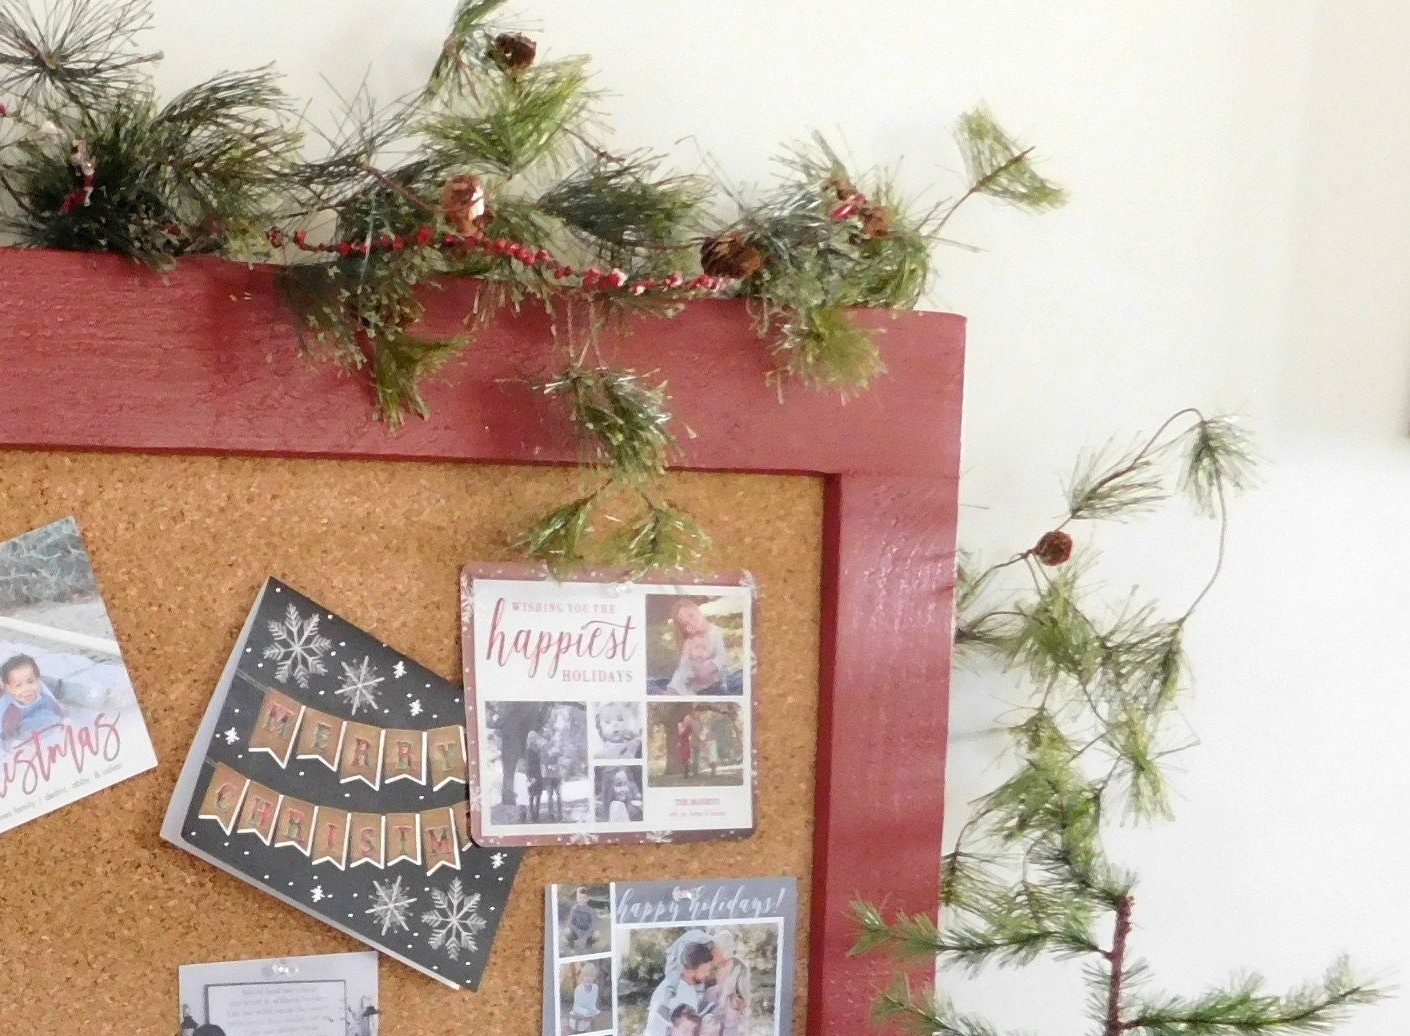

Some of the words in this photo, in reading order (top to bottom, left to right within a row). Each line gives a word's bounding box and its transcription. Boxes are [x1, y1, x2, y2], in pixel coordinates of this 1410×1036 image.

[511, 601, 564, 613] WISHING
[567, 603, 590, 614] YOU
[593, 604, 616, 615] THE
[486, 597, 637, 679] happiest
[561, 669, 633, 683] HOLIDAYS
[263, 701, 457, 772] MERRY
[214, 783, 456, 857] CHRISTM
[616, 887, 680, 924] happy
